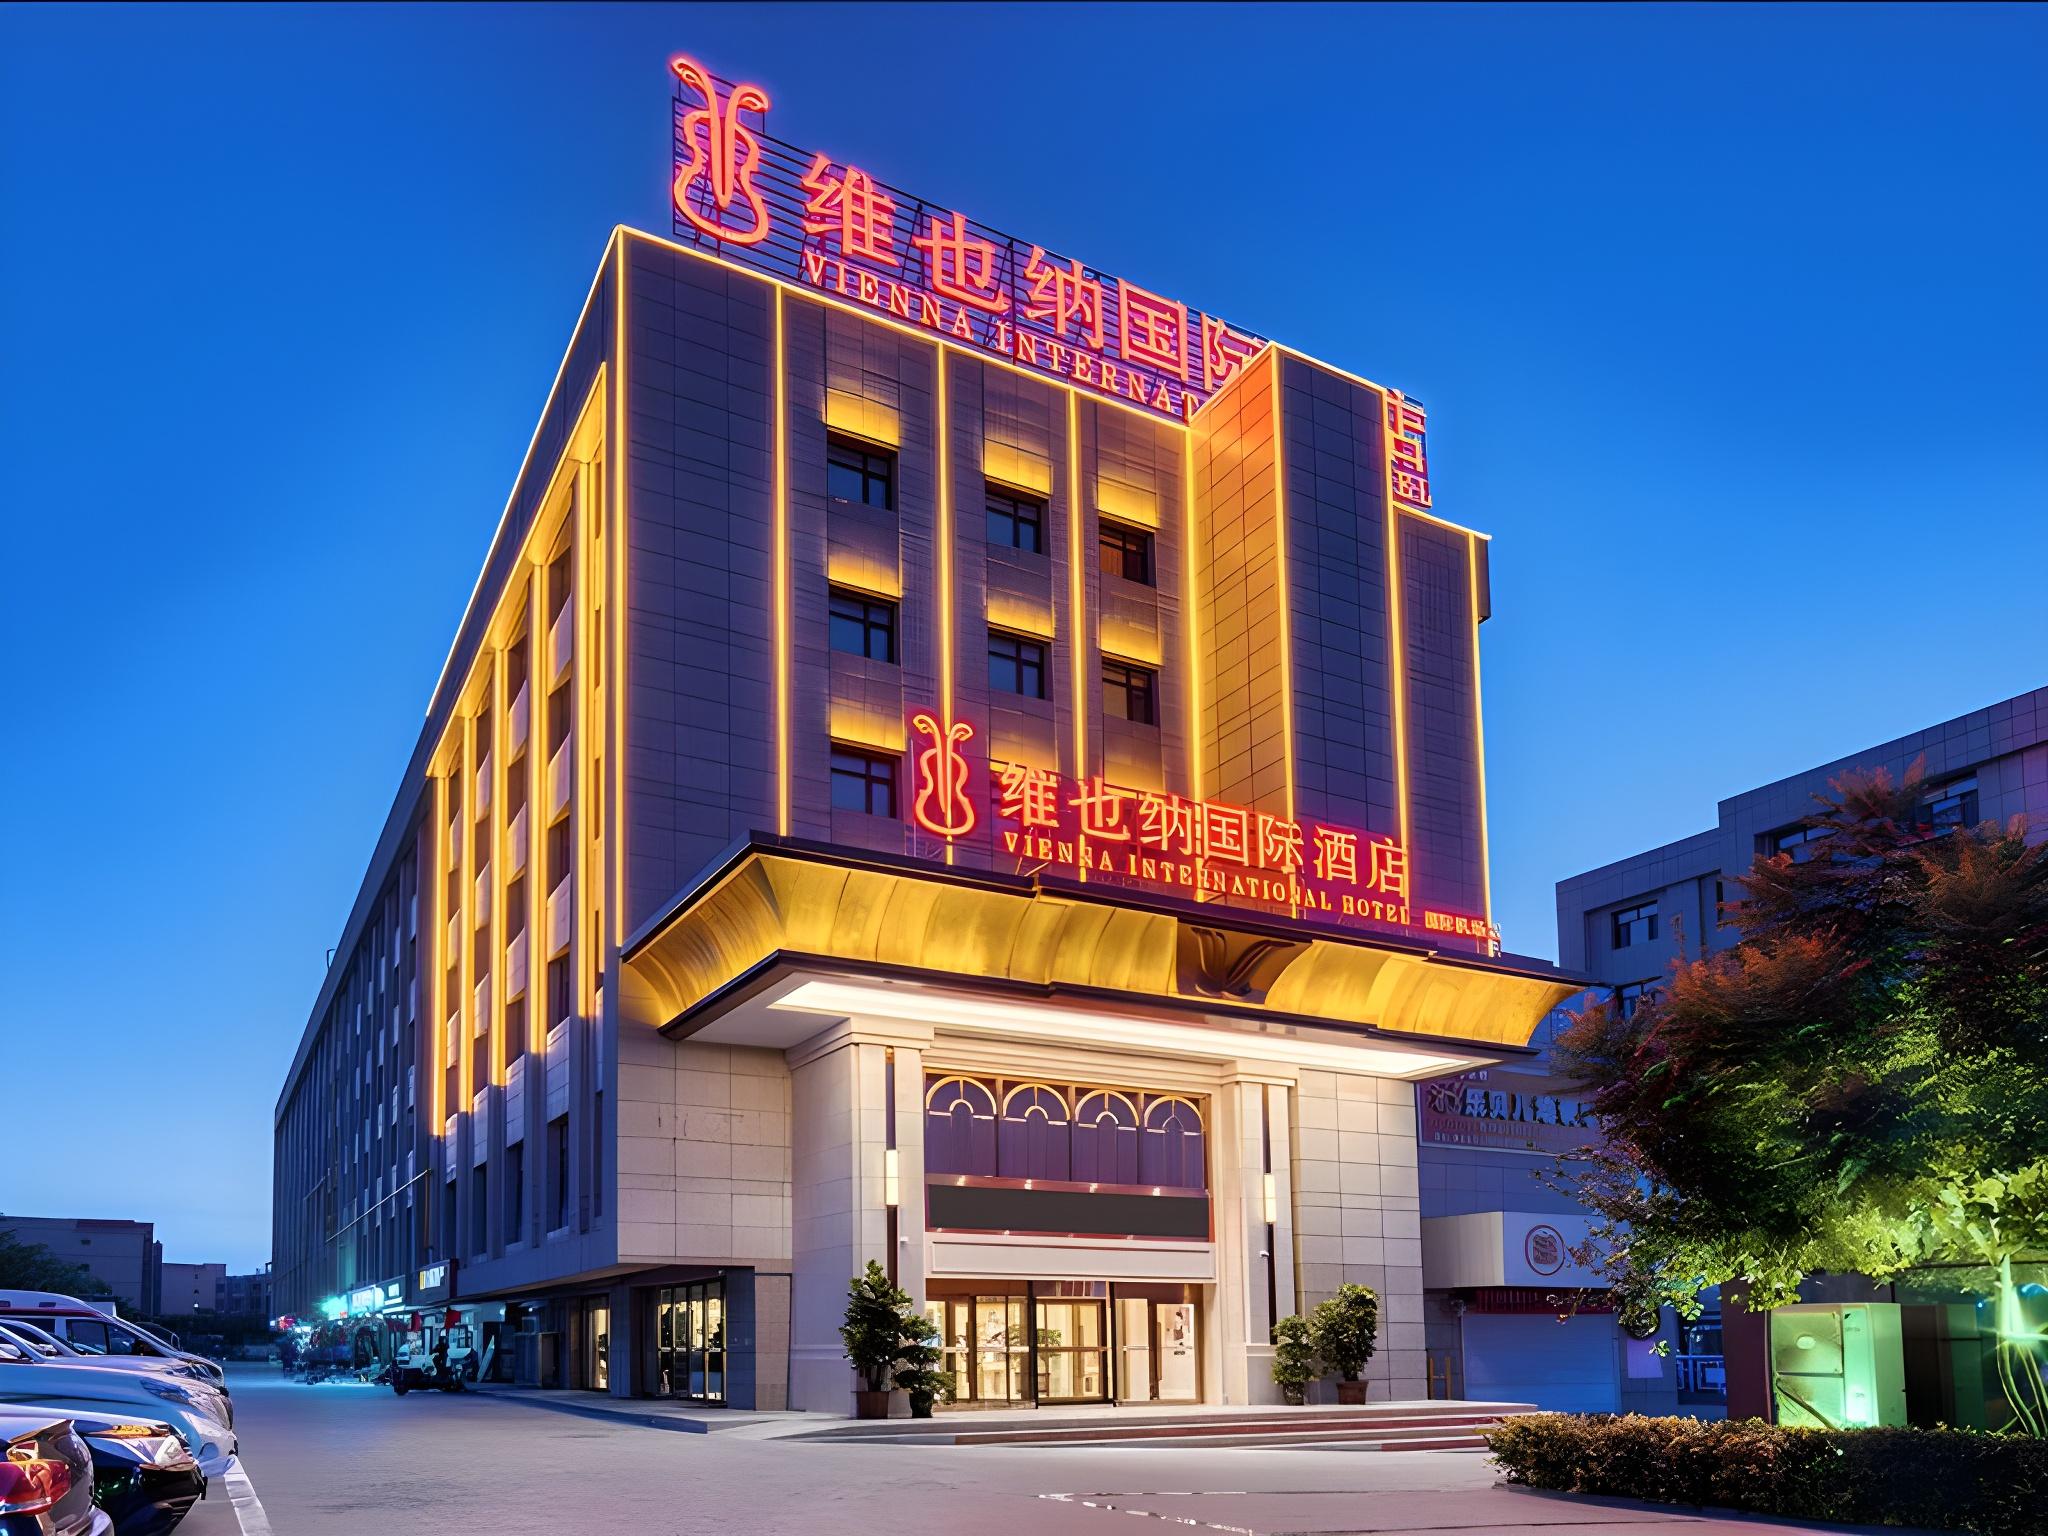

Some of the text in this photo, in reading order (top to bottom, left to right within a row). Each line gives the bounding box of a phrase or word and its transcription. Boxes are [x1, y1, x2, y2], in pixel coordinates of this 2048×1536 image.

[804, 250, 1199, 424] VIENNA INTERNAT
[1000, 761, 1408, 897] 维也纳国际酒店
[1003, 831, 1114, 872] VIENNA
[1128, 853, 1332, 911] INTERNATIONAL
